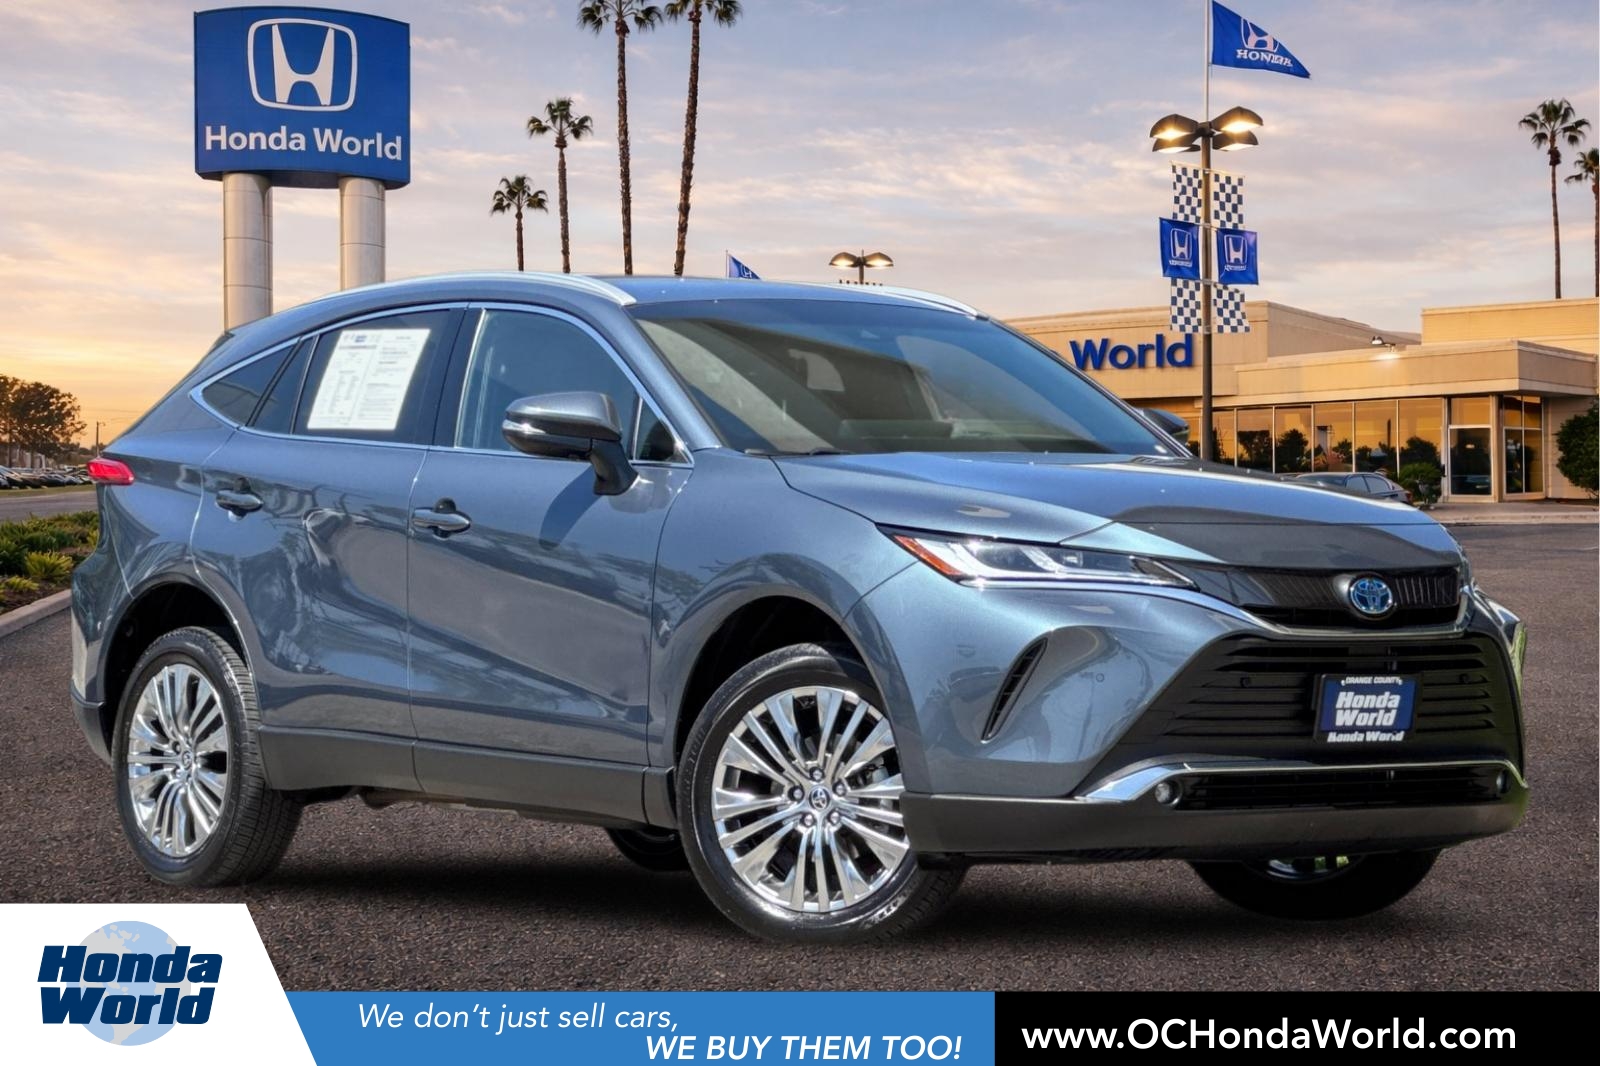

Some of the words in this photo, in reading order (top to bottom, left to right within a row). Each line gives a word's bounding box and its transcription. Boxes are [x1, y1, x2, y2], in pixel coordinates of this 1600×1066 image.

[205, 125, 306, 151] Honda
[313, 127, 402, 161] World
[1069, 333, 1193, 371] World
[1335, 691, 1400, 709] Honda
[1335, 709, 1397, 726] World
[1327, 731, 1365, 743] Honda
[1365, 730, 1405, 742] World
